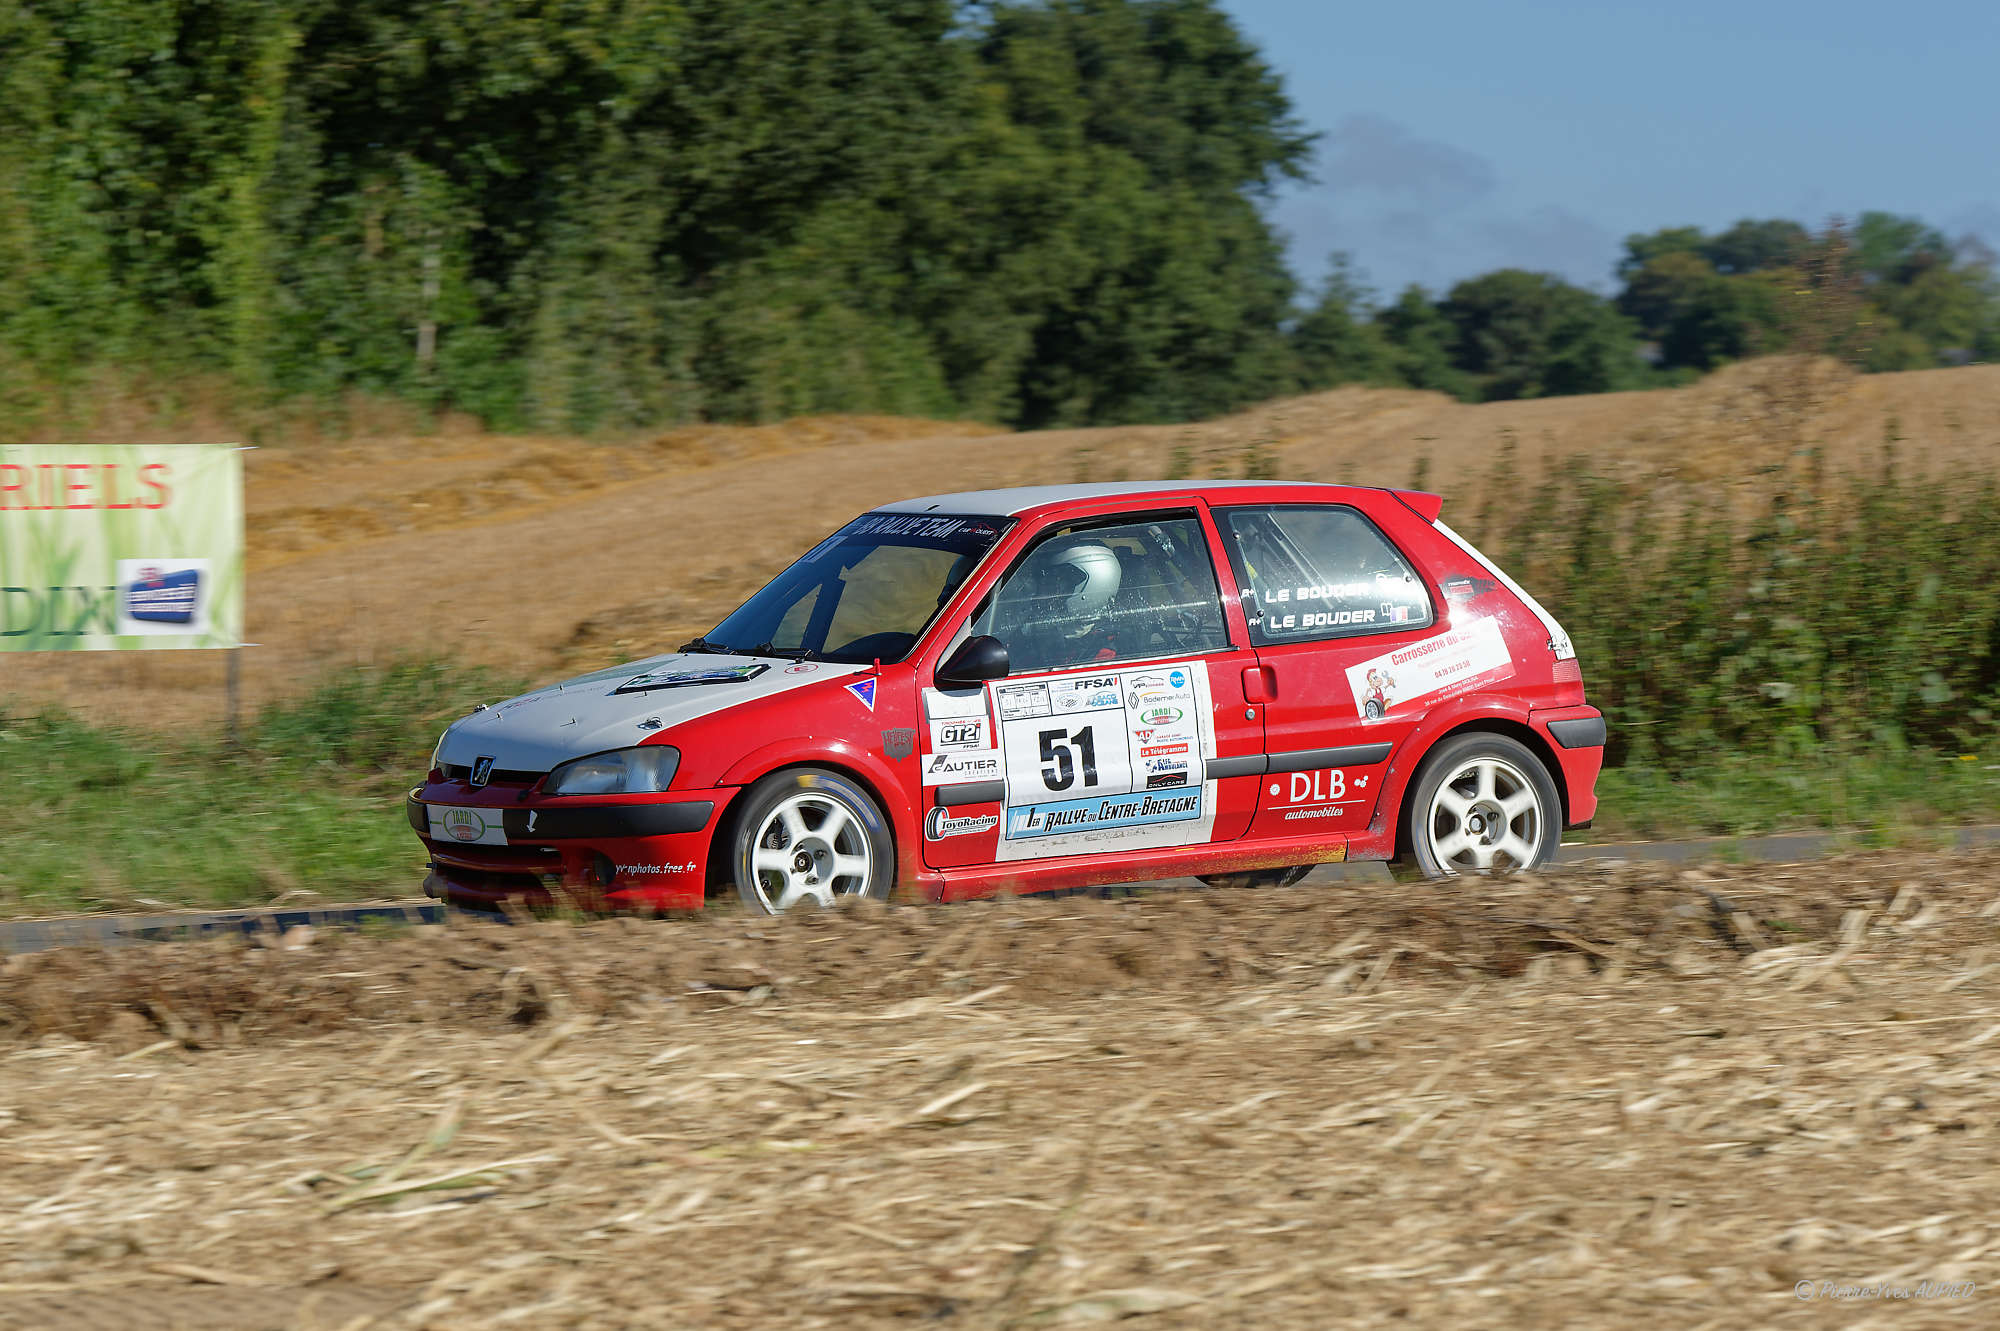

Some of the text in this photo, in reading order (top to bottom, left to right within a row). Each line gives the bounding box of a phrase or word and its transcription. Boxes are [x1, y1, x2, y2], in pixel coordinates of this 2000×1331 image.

[1265, 589, 1289, 603] LE
[1297, 583, 1369, 600] BOUDER
[1271, 615, 1295, 628] LE
[1302, 610, 1376, 626] BOUDER
[1391, 638, 1446, 666] Carrosserie
[1075, 678, 1113, 690] FFSA
[940, 723, 981, 743] GT2i
[1139, 731, 1152, 742] AD
[1039, 725, 1098, 791] 51
[1290, 769, 1346, 802] DLB
[942, 815, 998, 829] ToyoRacing
[1044, 808, 1089, 832] RALLYE
[1088, 813, 1098, 822] DU
[1098, 796, 1198, 821] CENTRE-BRETAGNE
[1285, 807, 1343, 820] automobiles
